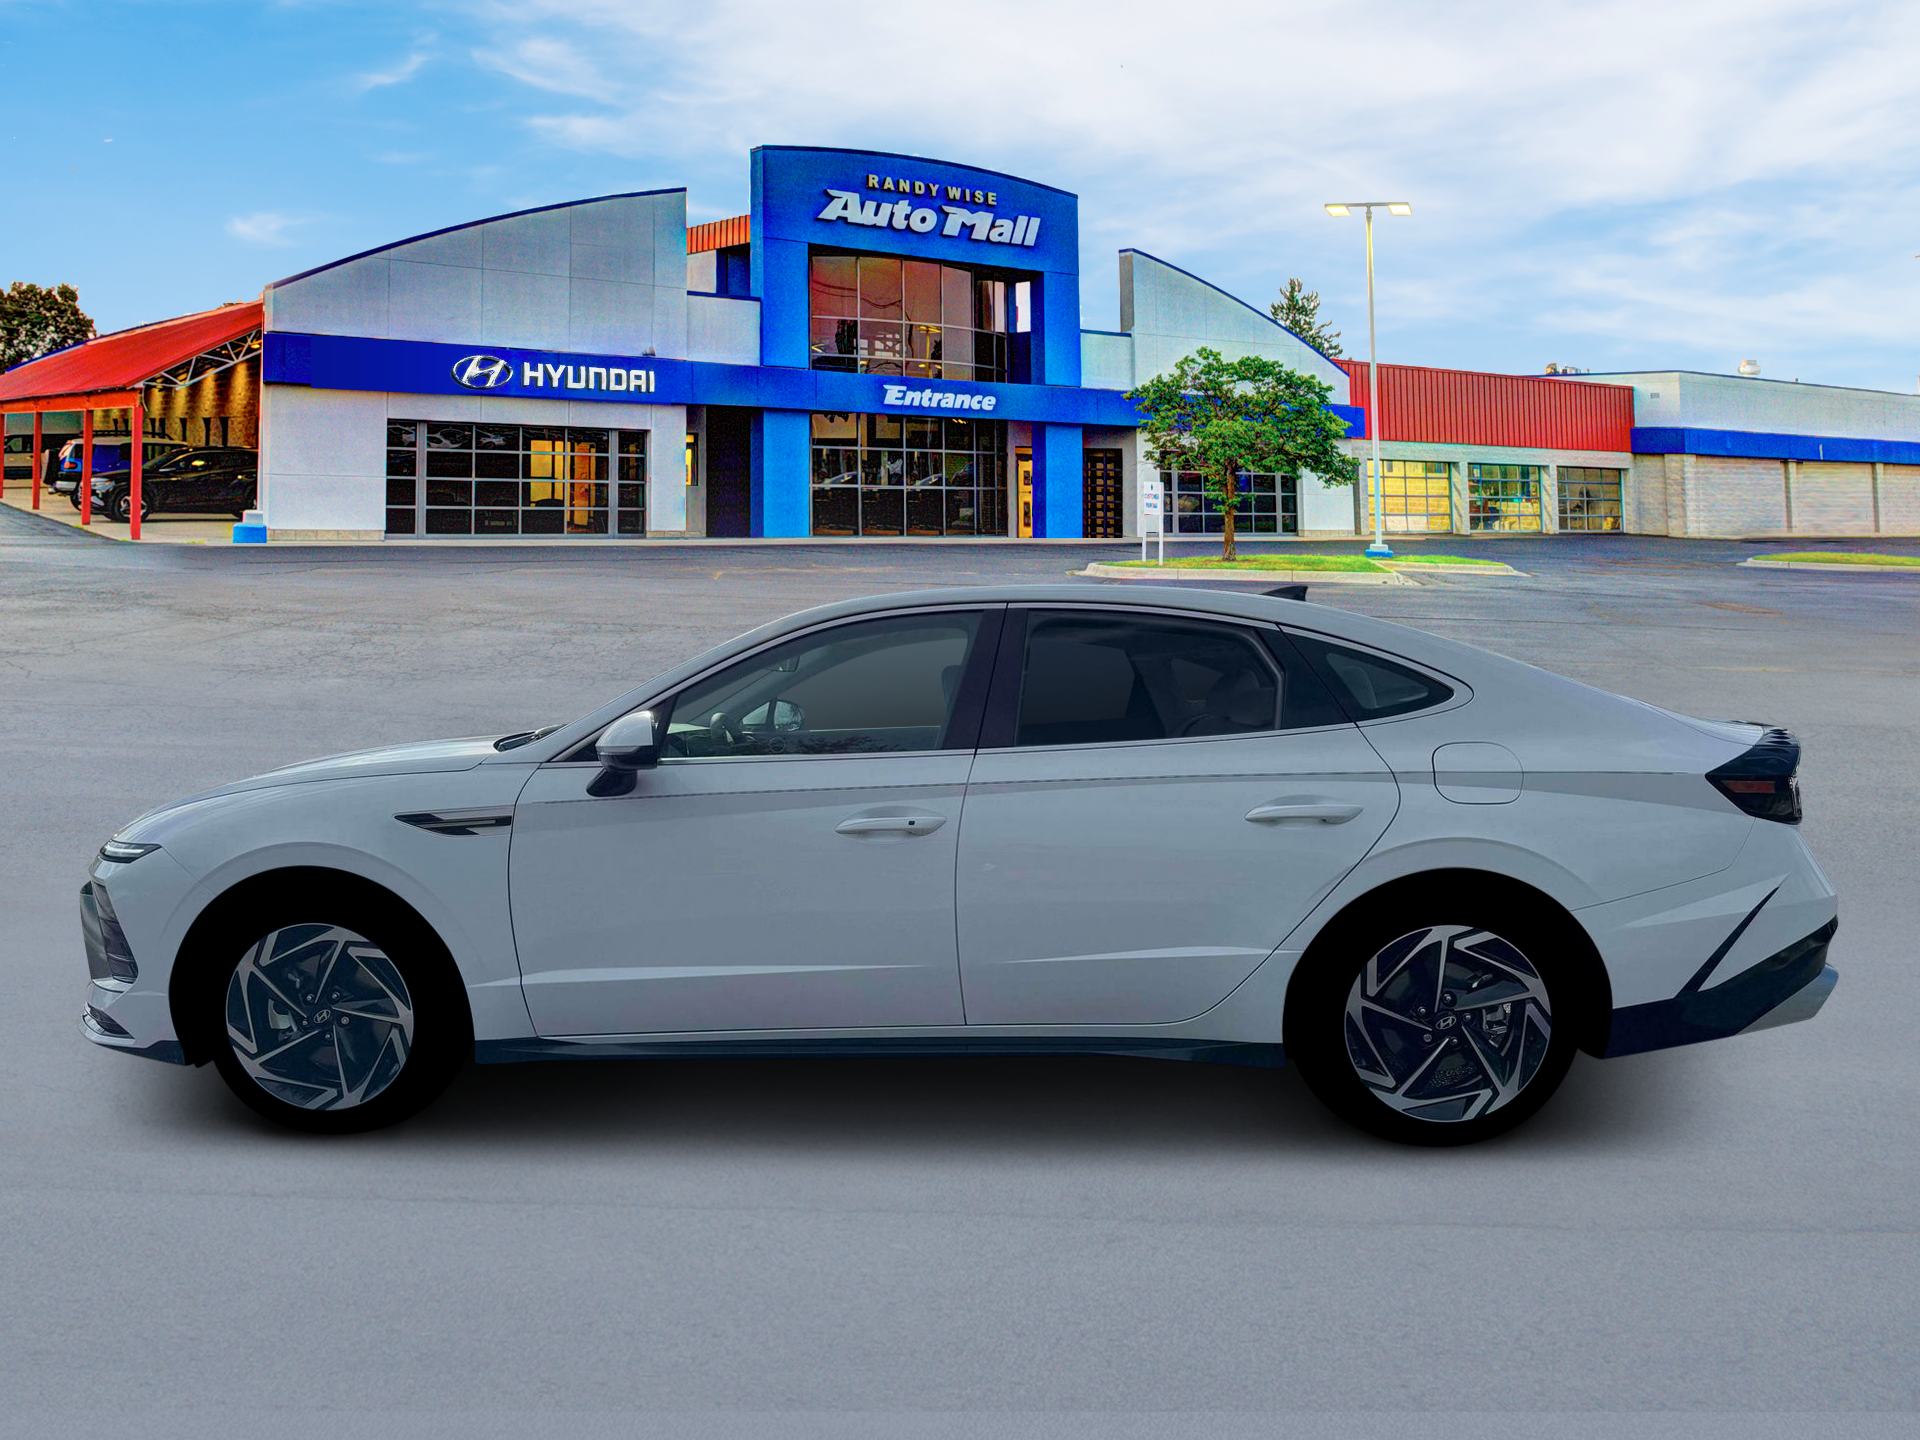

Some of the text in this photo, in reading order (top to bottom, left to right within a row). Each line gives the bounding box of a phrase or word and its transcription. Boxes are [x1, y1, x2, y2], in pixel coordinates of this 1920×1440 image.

[866, 174, 998, 206] RANDY WISE
[816, 188, 1041, 247] Auto Mall
[522, 362, 655, 393] HYUNDAI
[883, 384, 997, 411] Entrance
